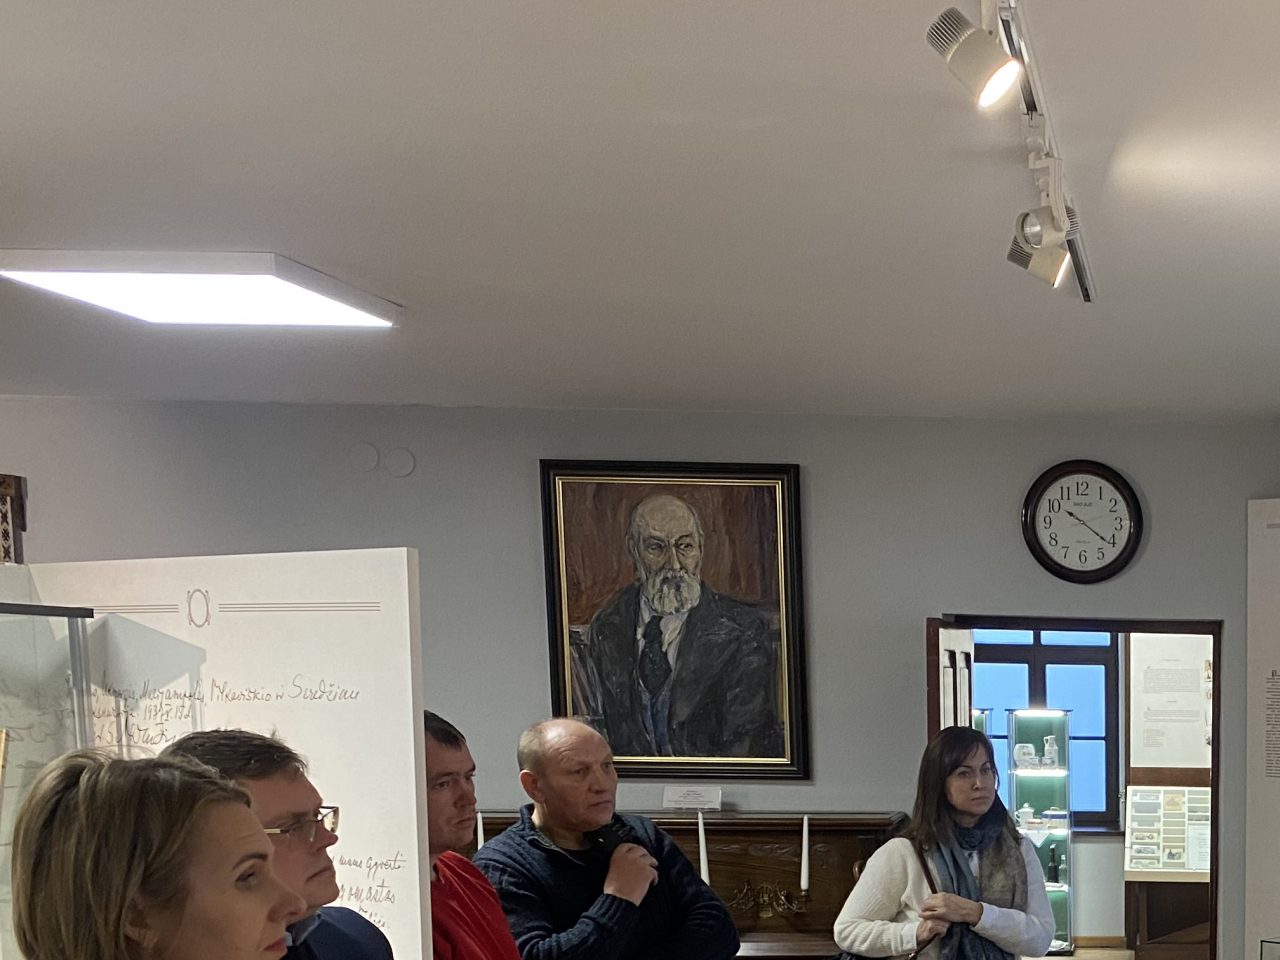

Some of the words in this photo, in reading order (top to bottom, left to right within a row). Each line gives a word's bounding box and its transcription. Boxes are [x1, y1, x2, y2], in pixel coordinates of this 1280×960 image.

[1060, 486, 1071, 500] 11
[1075, 481, 1089, 496] 12
[1098, 486, 1103, 500] 1
[1047, 498, 1061, 513] 10
[1108, 498, 1118, 513] 2
[1043, 515, 1052, 529] 9
[1114, 516, 1123, 531] 3
[1048, 532, 1058, 547] 8
[1107, 533, 1117, 548] 4
[1061, 546, 1070, 559] 7
[1078, 549, 1087, 564] 6
[1096, 547, 1105, 560] 5
